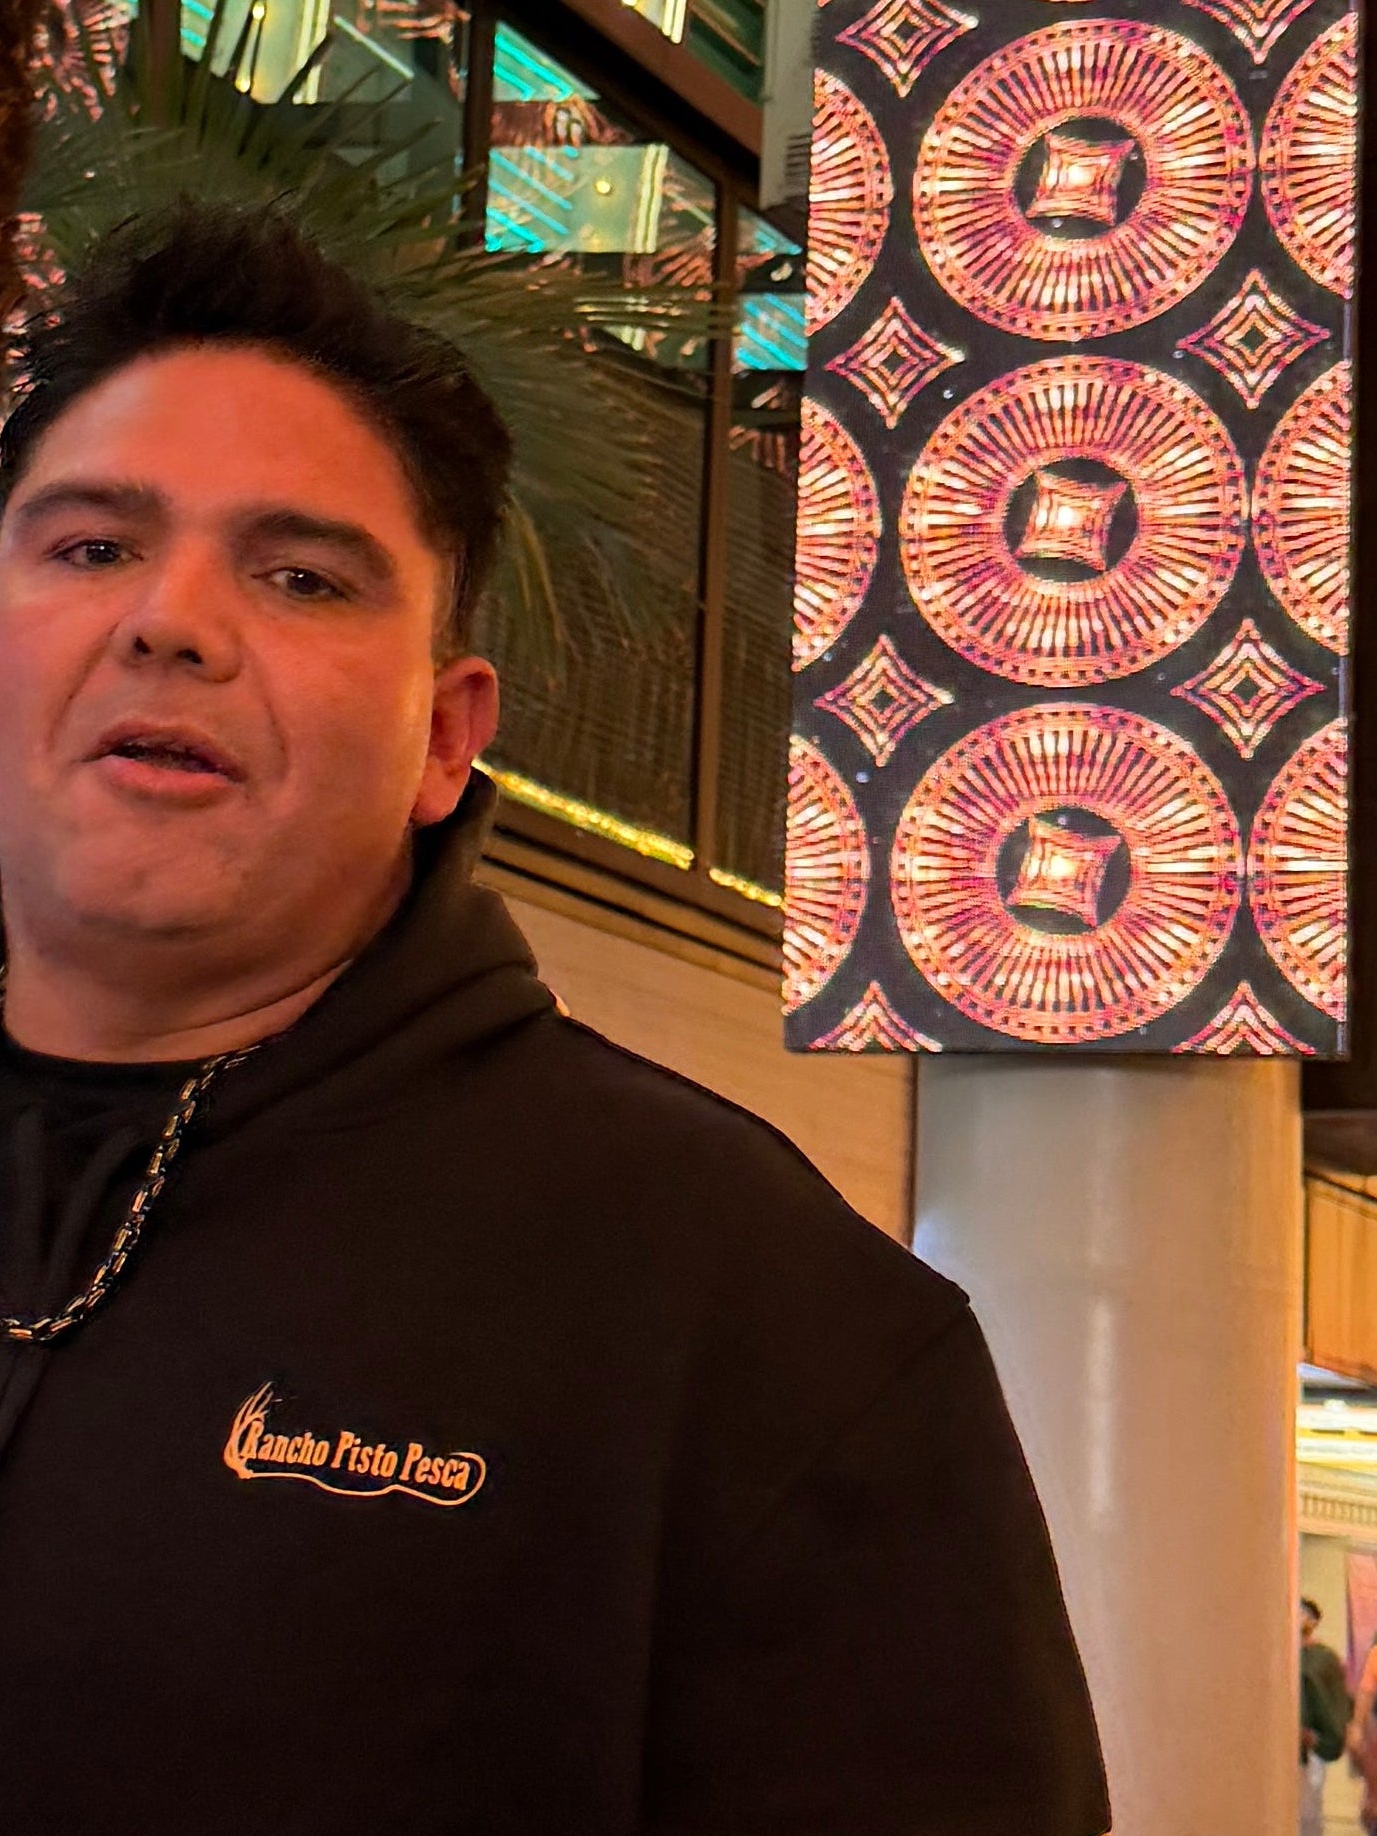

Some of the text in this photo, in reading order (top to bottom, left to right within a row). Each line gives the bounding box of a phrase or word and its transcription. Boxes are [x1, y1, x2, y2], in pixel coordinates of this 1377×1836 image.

[239, 1420, 470, 1491] Rancho Pisto Pesca
